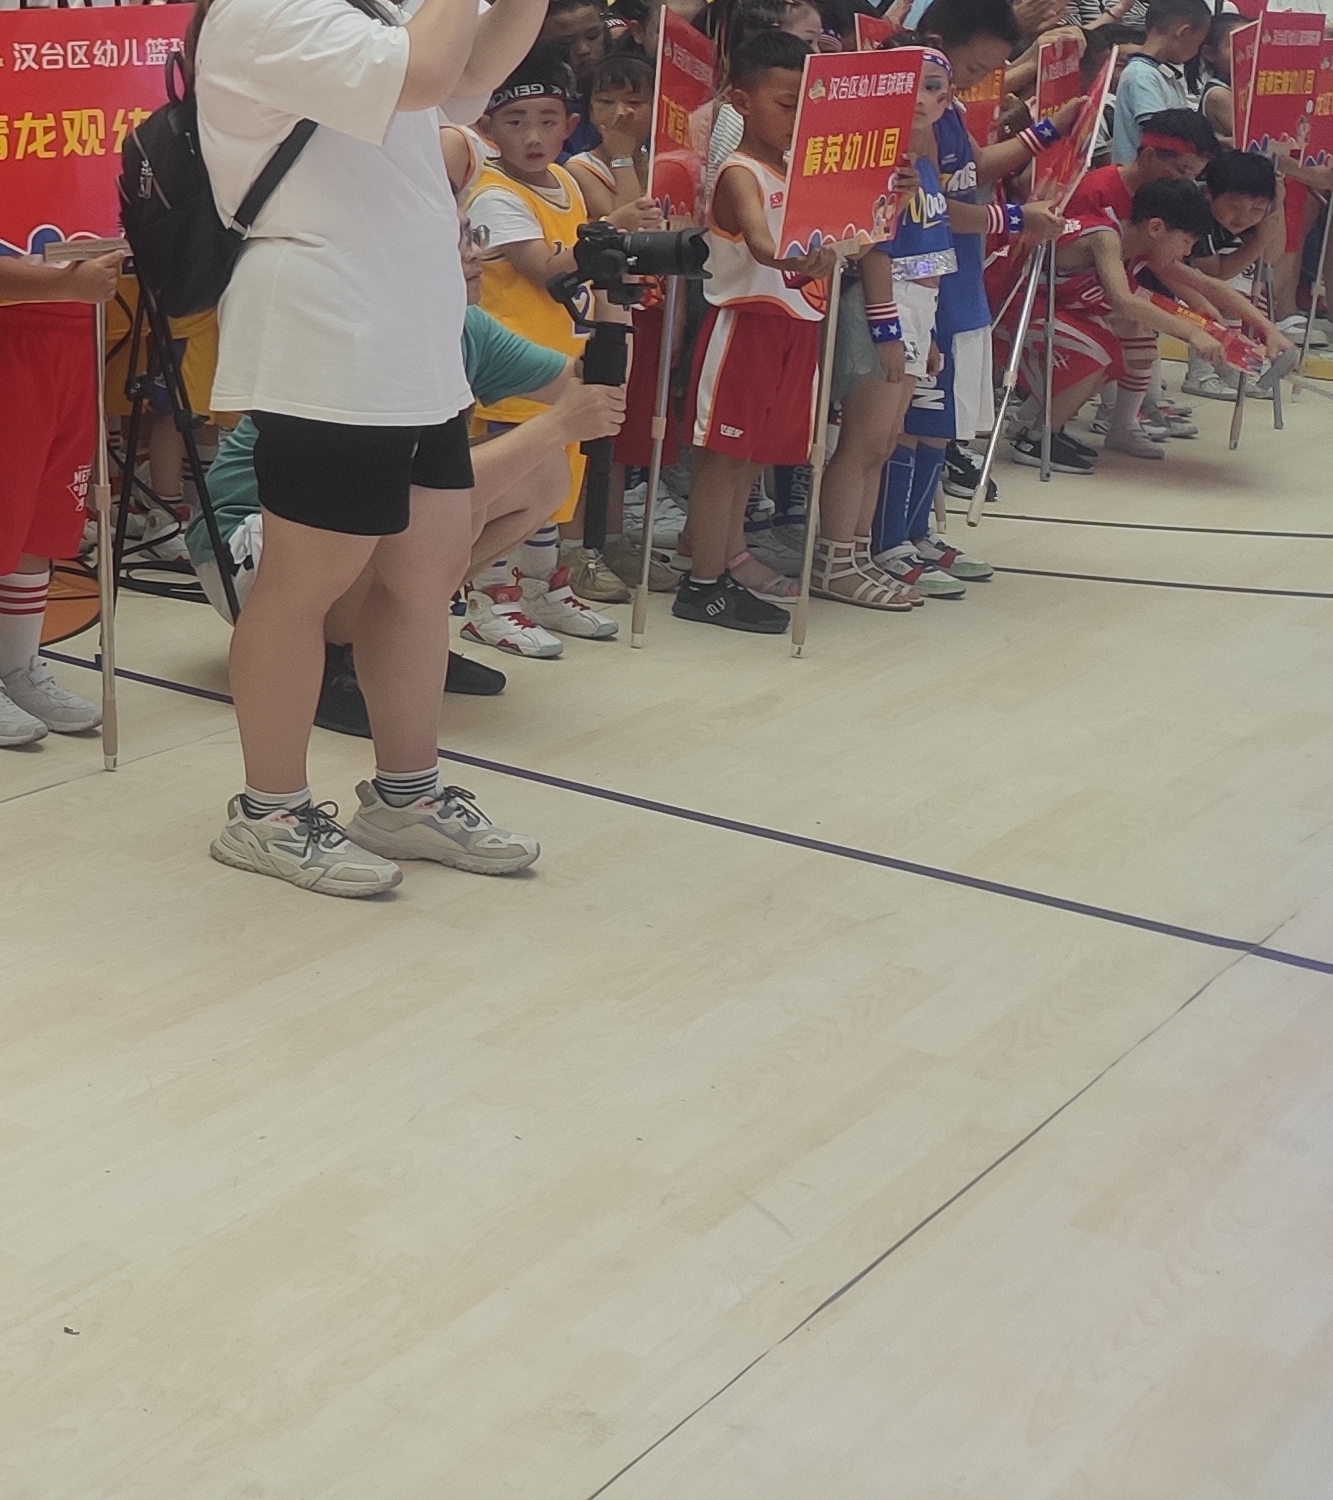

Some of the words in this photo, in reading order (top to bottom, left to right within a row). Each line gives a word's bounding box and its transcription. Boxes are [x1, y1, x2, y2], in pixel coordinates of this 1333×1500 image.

[802, 127, 901, 177] 精英幼儿园
